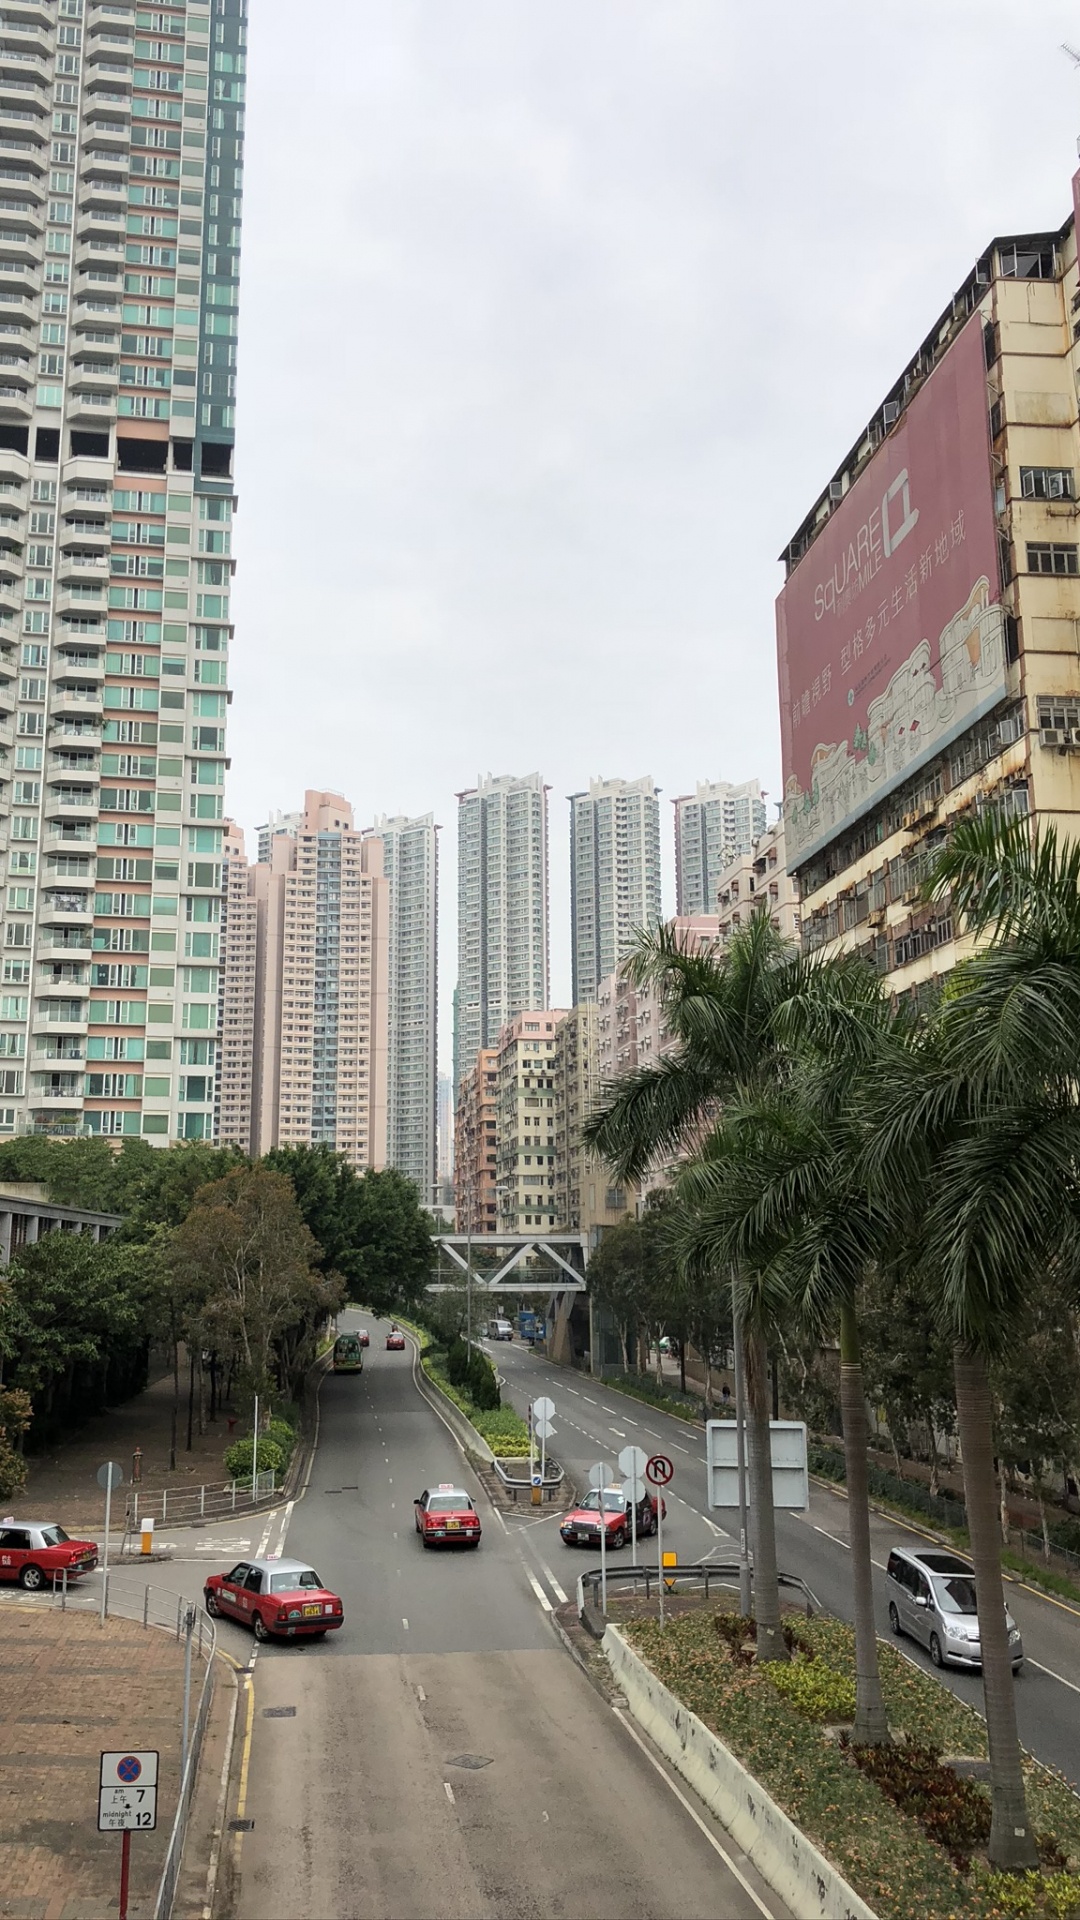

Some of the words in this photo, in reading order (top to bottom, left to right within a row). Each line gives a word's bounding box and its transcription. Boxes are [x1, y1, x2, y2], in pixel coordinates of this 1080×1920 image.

[858, 546, 883, 593] MILE
[792, 663, 832, 729] 前瞻視野
[840, 509, 966, 676] 型格多元生活新地域
[111, 1795, 127, 1804] 上午
[136, 1789, 145, 1803] 7
[102, 1810, 132, 1818] midnight
[136, 1812, 151, 1826] 12
[109, 1818, 126, 1827] 午夜
